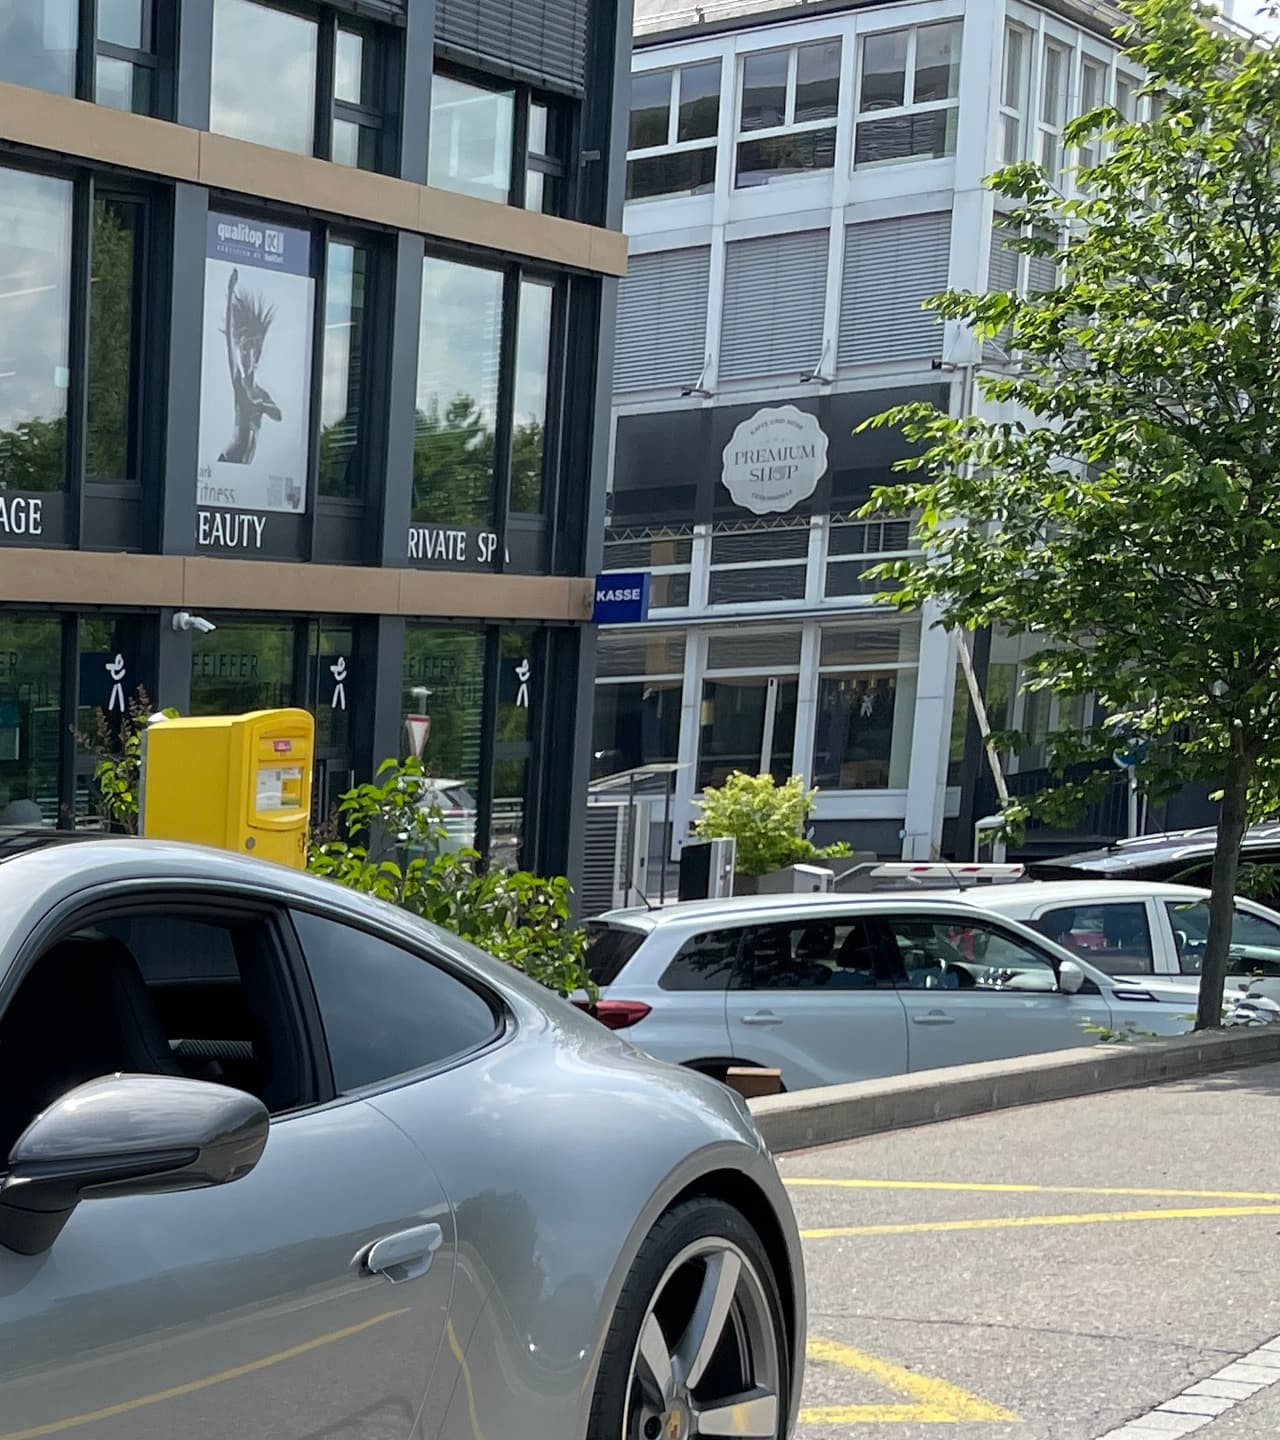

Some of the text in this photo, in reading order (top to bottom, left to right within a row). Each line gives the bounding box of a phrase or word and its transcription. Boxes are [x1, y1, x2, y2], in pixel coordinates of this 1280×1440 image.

[217, 223, 263, 248] qualitop
[735, 444, 815, 465] PREMIUM
[749, 464, 799, 482] SHOP
[197, 511, 267, 549] EAUTY
[408, 527, 467, 562] RIVATE
[596, 588, 640, 602] KASSE
